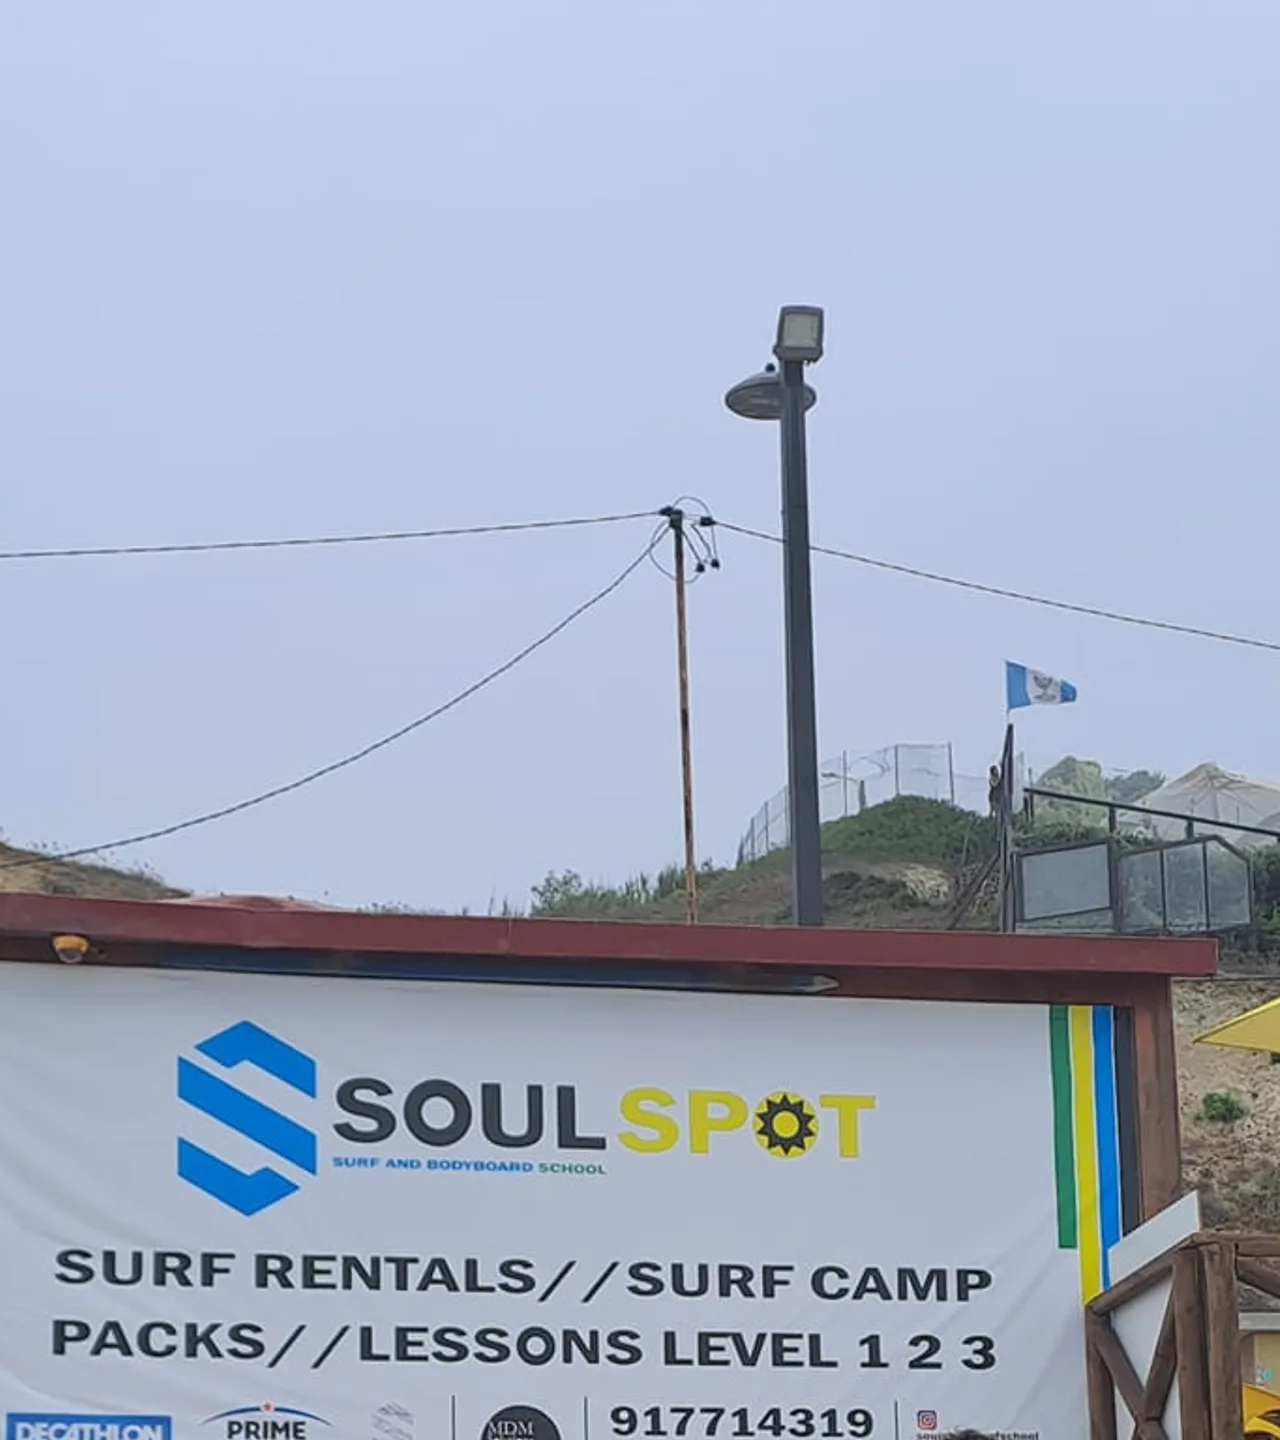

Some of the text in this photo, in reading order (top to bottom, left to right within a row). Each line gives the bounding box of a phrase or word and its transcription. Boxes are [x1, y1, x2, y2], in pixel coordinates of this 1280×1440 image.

[332, 1156, 608, 1176] SURF AND BODYBOARD SCHOOL
[54, 1248, 236, 1288] SURF
[810, 1265, 994, 1302] CAMP
[662, 1330, 839, 1369] LEVEL
[858, 1334, 889, 1369] 1
[907, 1334, 943, 1370] 2
[960, 1335, 997, 1371] 3
[486, 1419, 535, 1437] MDM
[609, 1405, 874, 1438] 917714319
